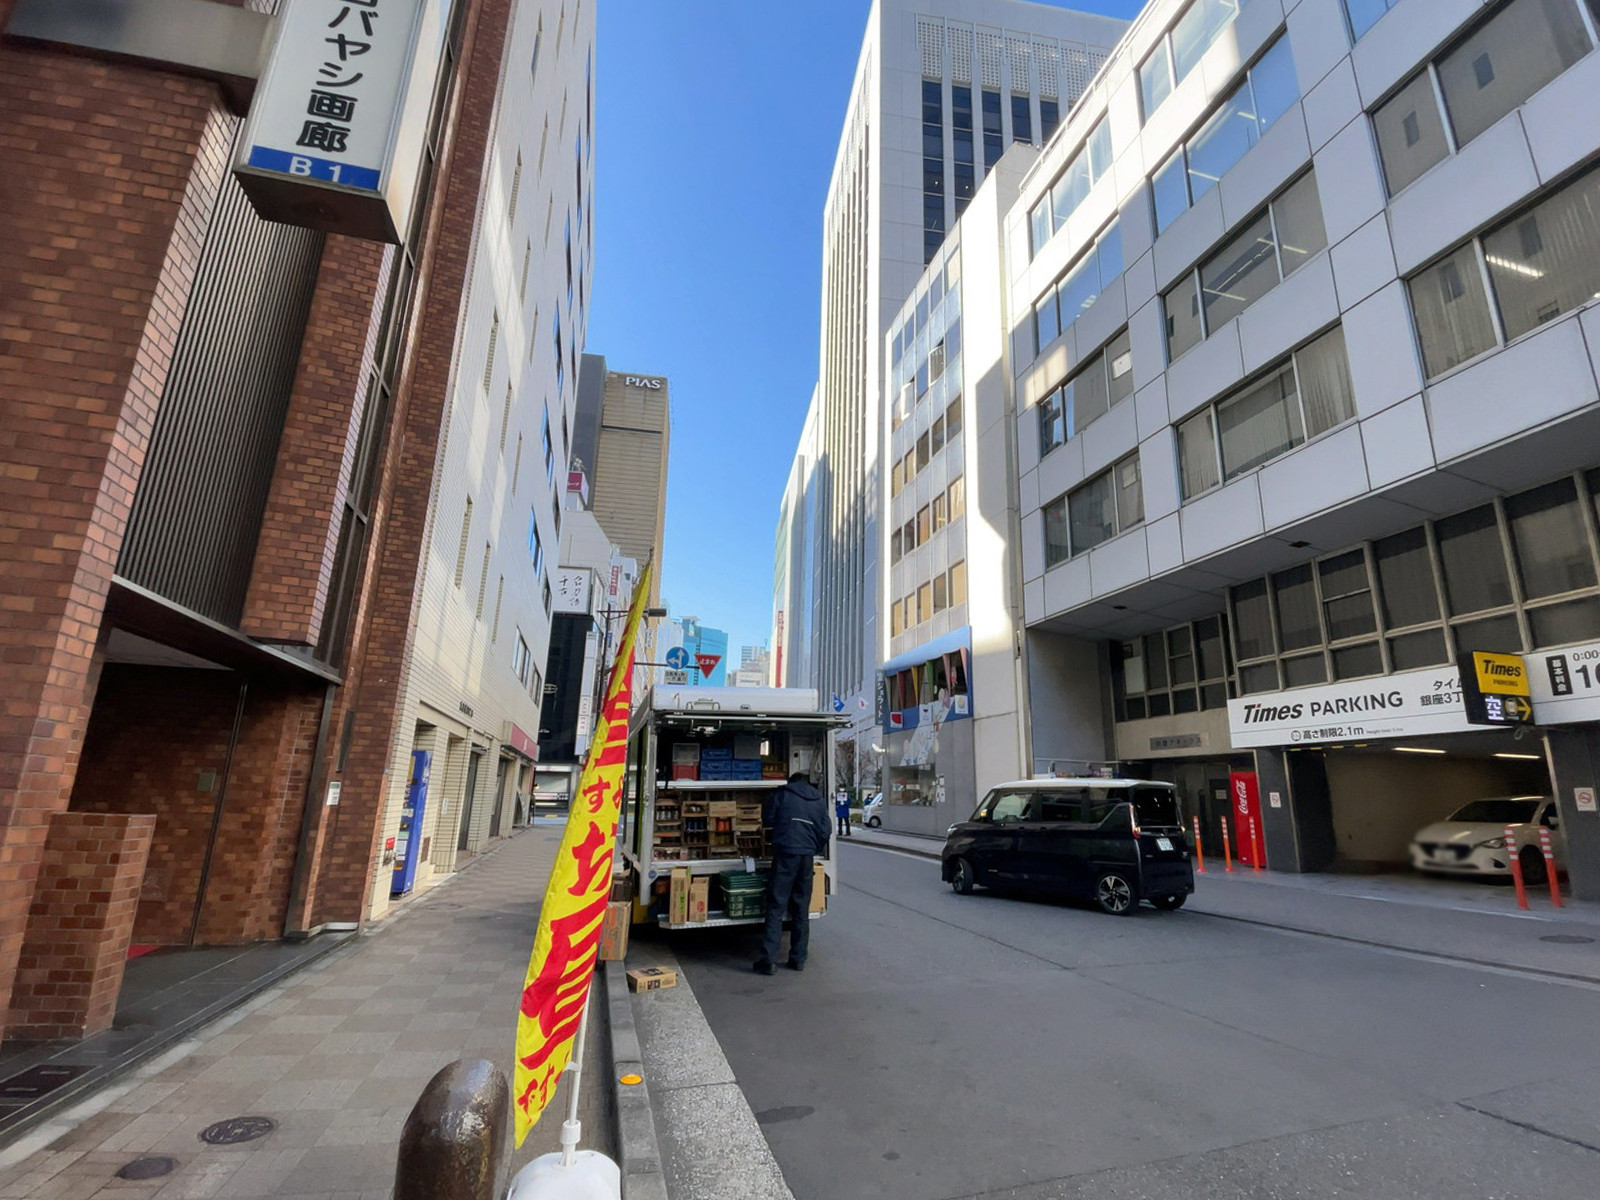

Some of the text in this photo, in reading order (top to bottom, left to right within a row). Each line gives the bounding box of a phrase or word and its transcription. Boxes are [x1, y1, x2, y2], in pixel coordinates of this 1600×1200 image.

[625, 376, 661, 389] PIAS
[1482, 659, 1522, 677] Times
[1243, 691, 1403, 724] Times PARKING
[1303, 726, 1364, 740] 高さ制限2.1m
